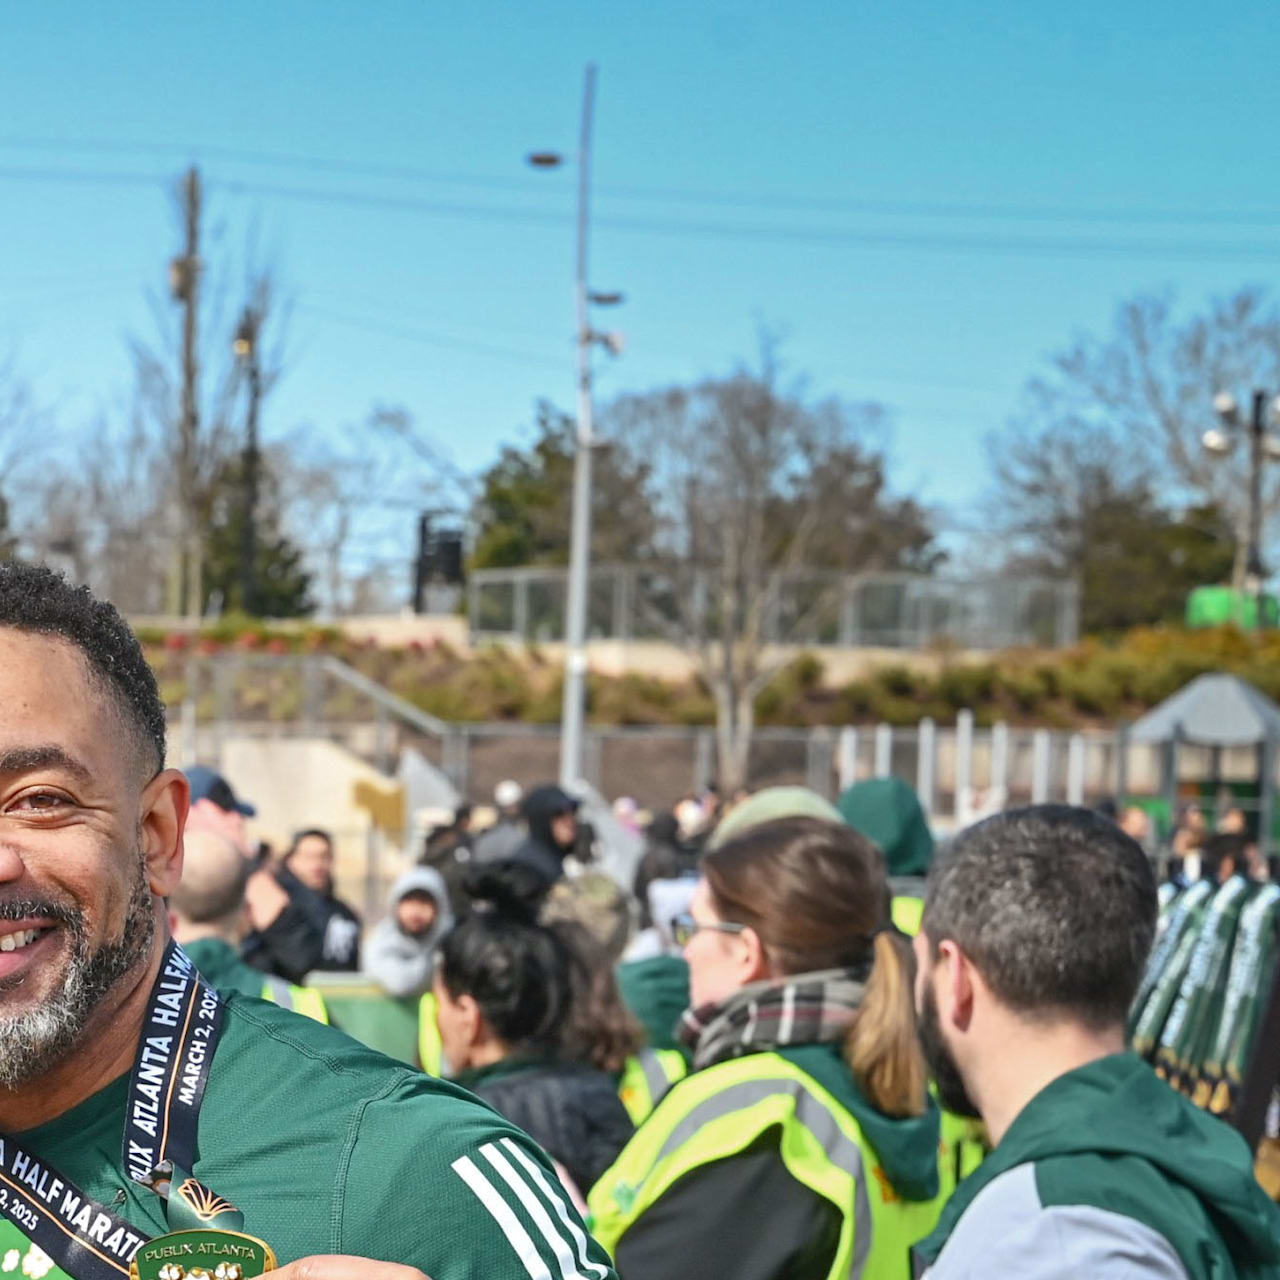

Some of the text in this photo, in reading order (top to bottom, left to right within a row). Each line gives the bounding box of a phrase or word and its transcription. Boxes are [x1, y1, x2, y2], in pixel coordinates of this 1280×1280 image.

[152, 965, 189, 1027] HALF
[133, 1036, 173, 1137] ATLANTA
[178, 1040, 207, 1106] MARCH
[195, 1025, 215, 1038] 2,
[10, 1199, 40, 1231] 2025
[11, 1150, 64, 1202] HALF
[60, 1189, 145, 1261] MARAT
[144, 1243, 256, 1262] PUBLIX ATLANTA
